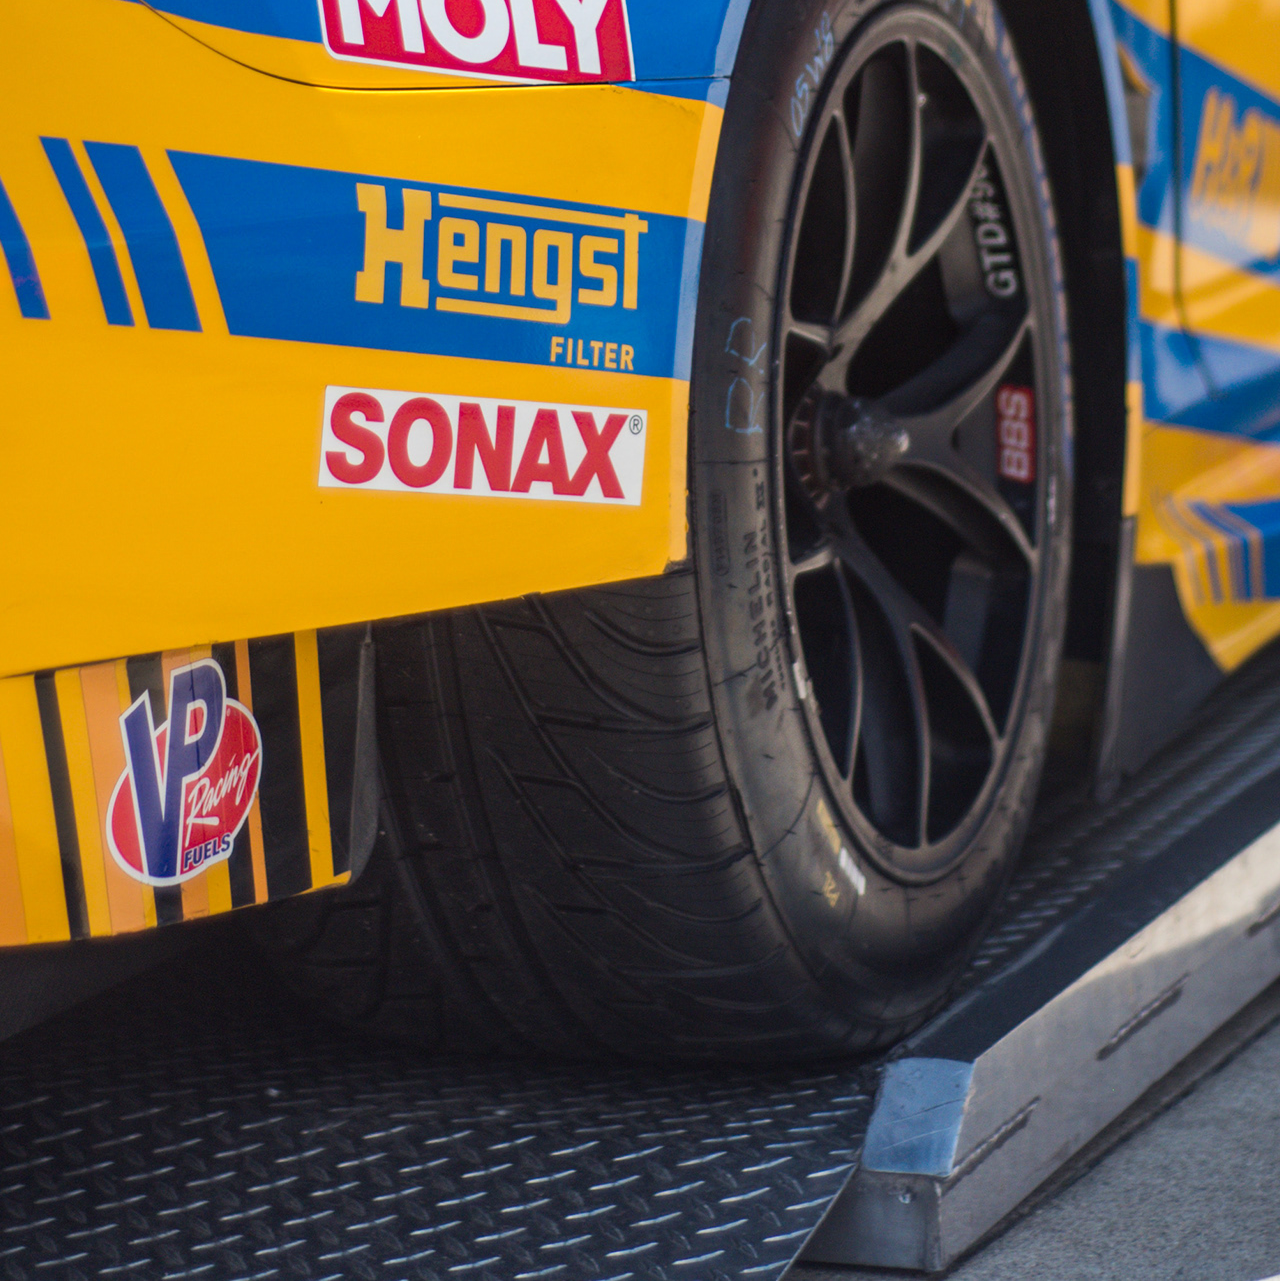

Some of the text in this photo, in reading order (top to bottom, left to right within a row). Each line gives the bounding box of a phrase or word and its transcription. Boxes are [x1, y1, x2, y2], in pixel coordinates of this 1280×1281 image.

[355, 182, 648, 325] Hengst
[549, 336, 635, 371] FILTER
[998, 389, 1030, 480] BBS
[742, 530, 778, 710] MICHELIN
[123, 662, 225, 879] VP
[185, 752, 260, 848] Racing
[184, 833, 232, 870] FUELS
